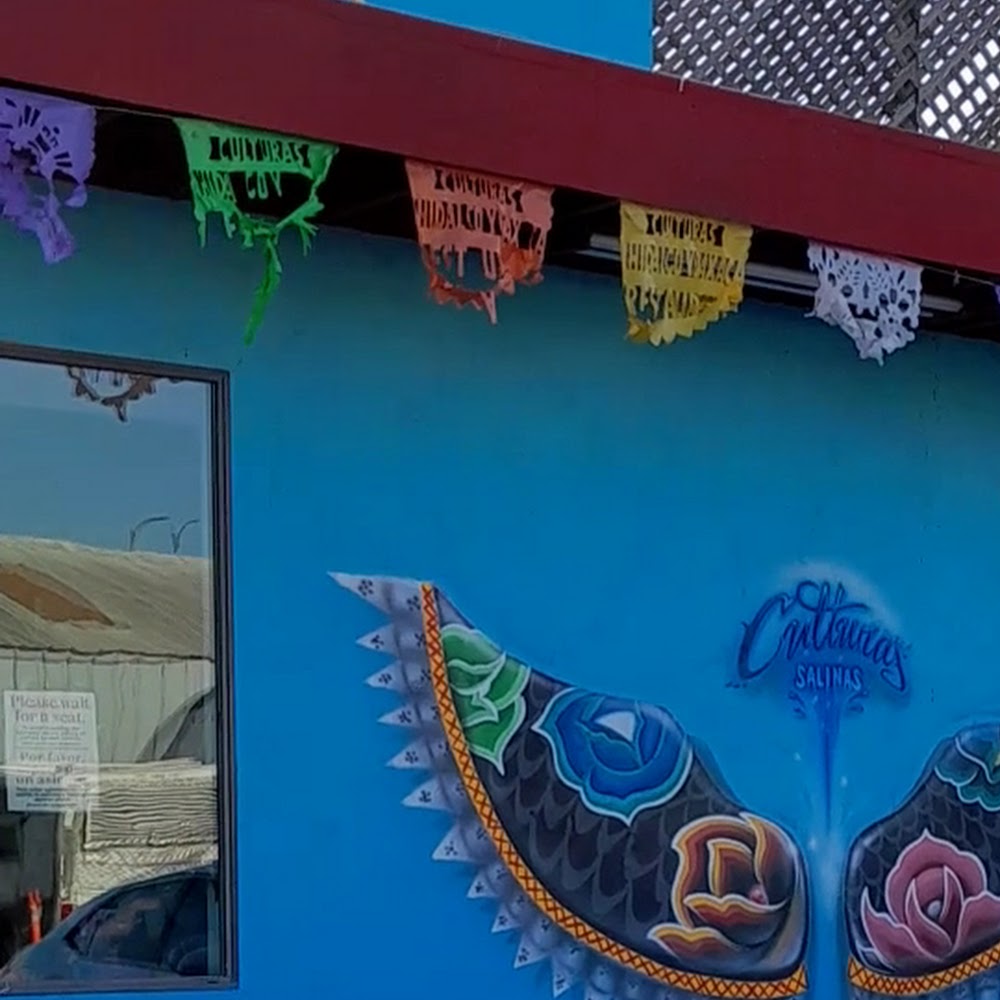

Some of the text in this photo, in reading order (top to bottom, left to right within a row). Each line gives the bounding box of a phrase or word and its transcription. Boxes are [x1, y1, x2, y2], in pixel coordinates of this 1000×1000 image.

[795, 663, 863, 692] SALINAS
[11, 694, 89, 709] Please wait
[15, 709, 38, 723] for
